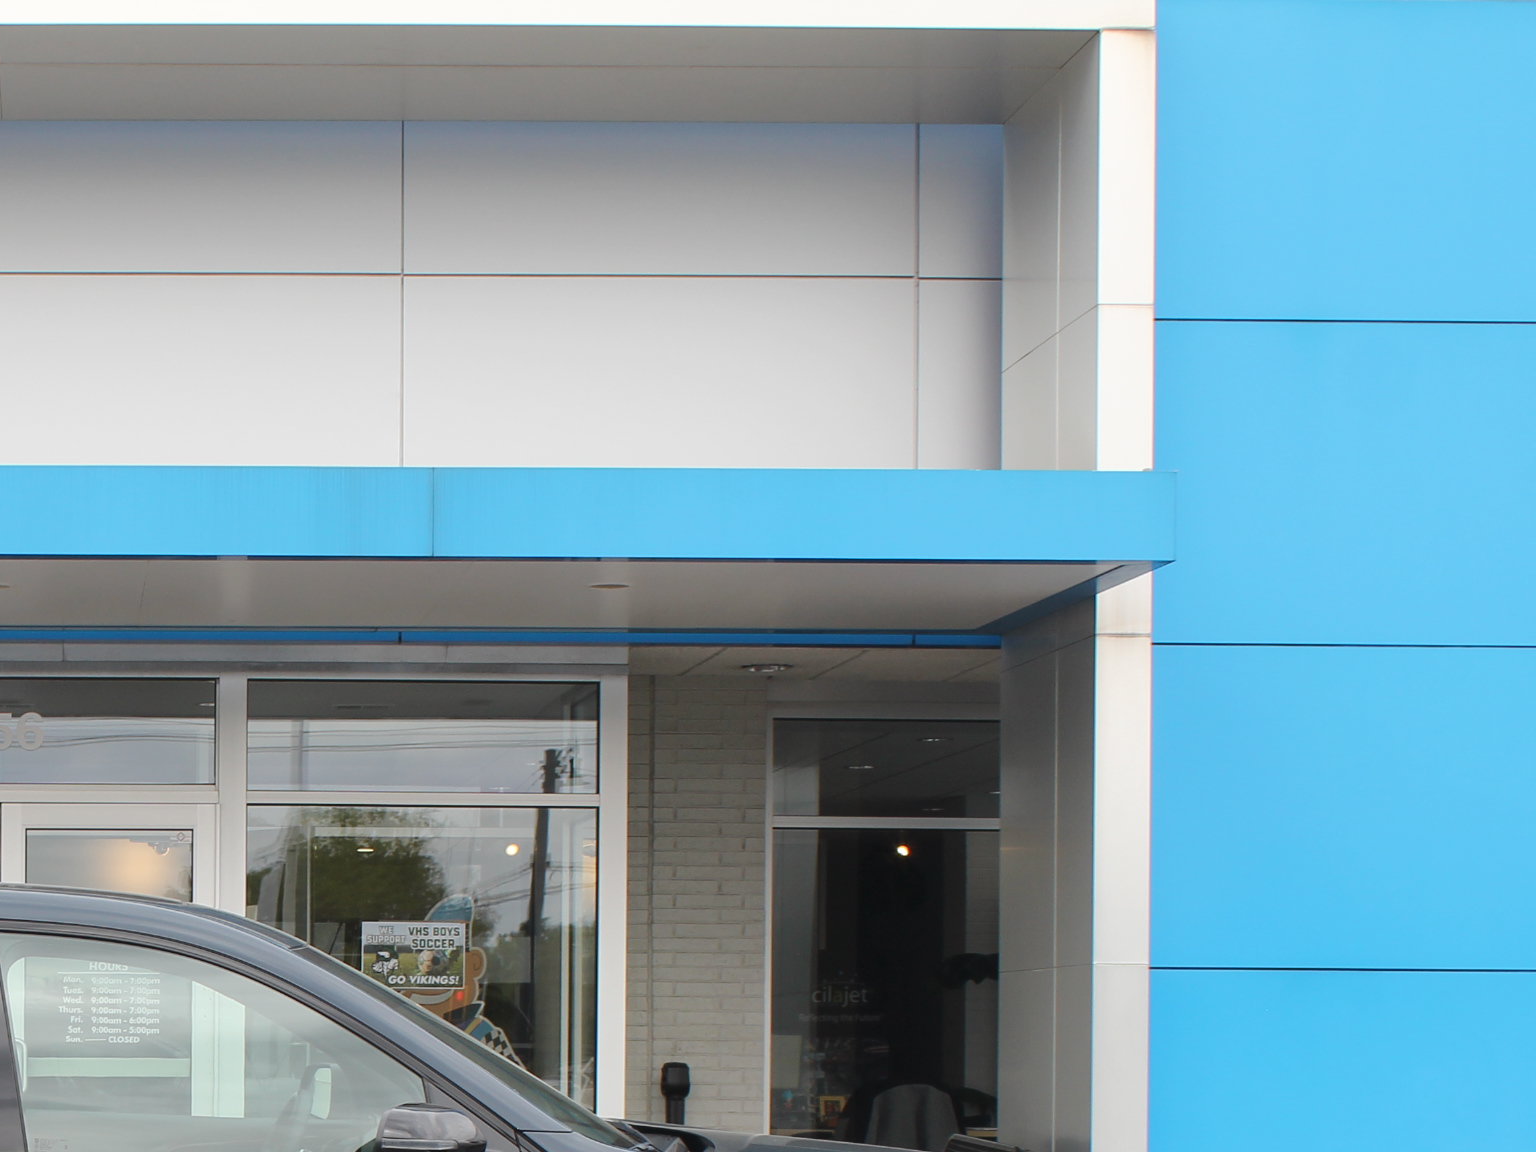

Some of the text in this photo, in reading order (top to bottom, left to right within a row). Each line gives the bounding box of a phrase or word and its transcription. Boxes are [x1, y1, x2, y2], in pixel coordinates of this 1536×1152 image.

[378, 926, 394, 934] WE
[408, 927, 460, 936] VHS BOYS
[367, 935, 405, 943] SUPPORT
[411, 939, 455, 949] SOCCER
[388, 975, 459, 984] GO VIKINGS!
[811, 984, 868, 1008] cilajet
